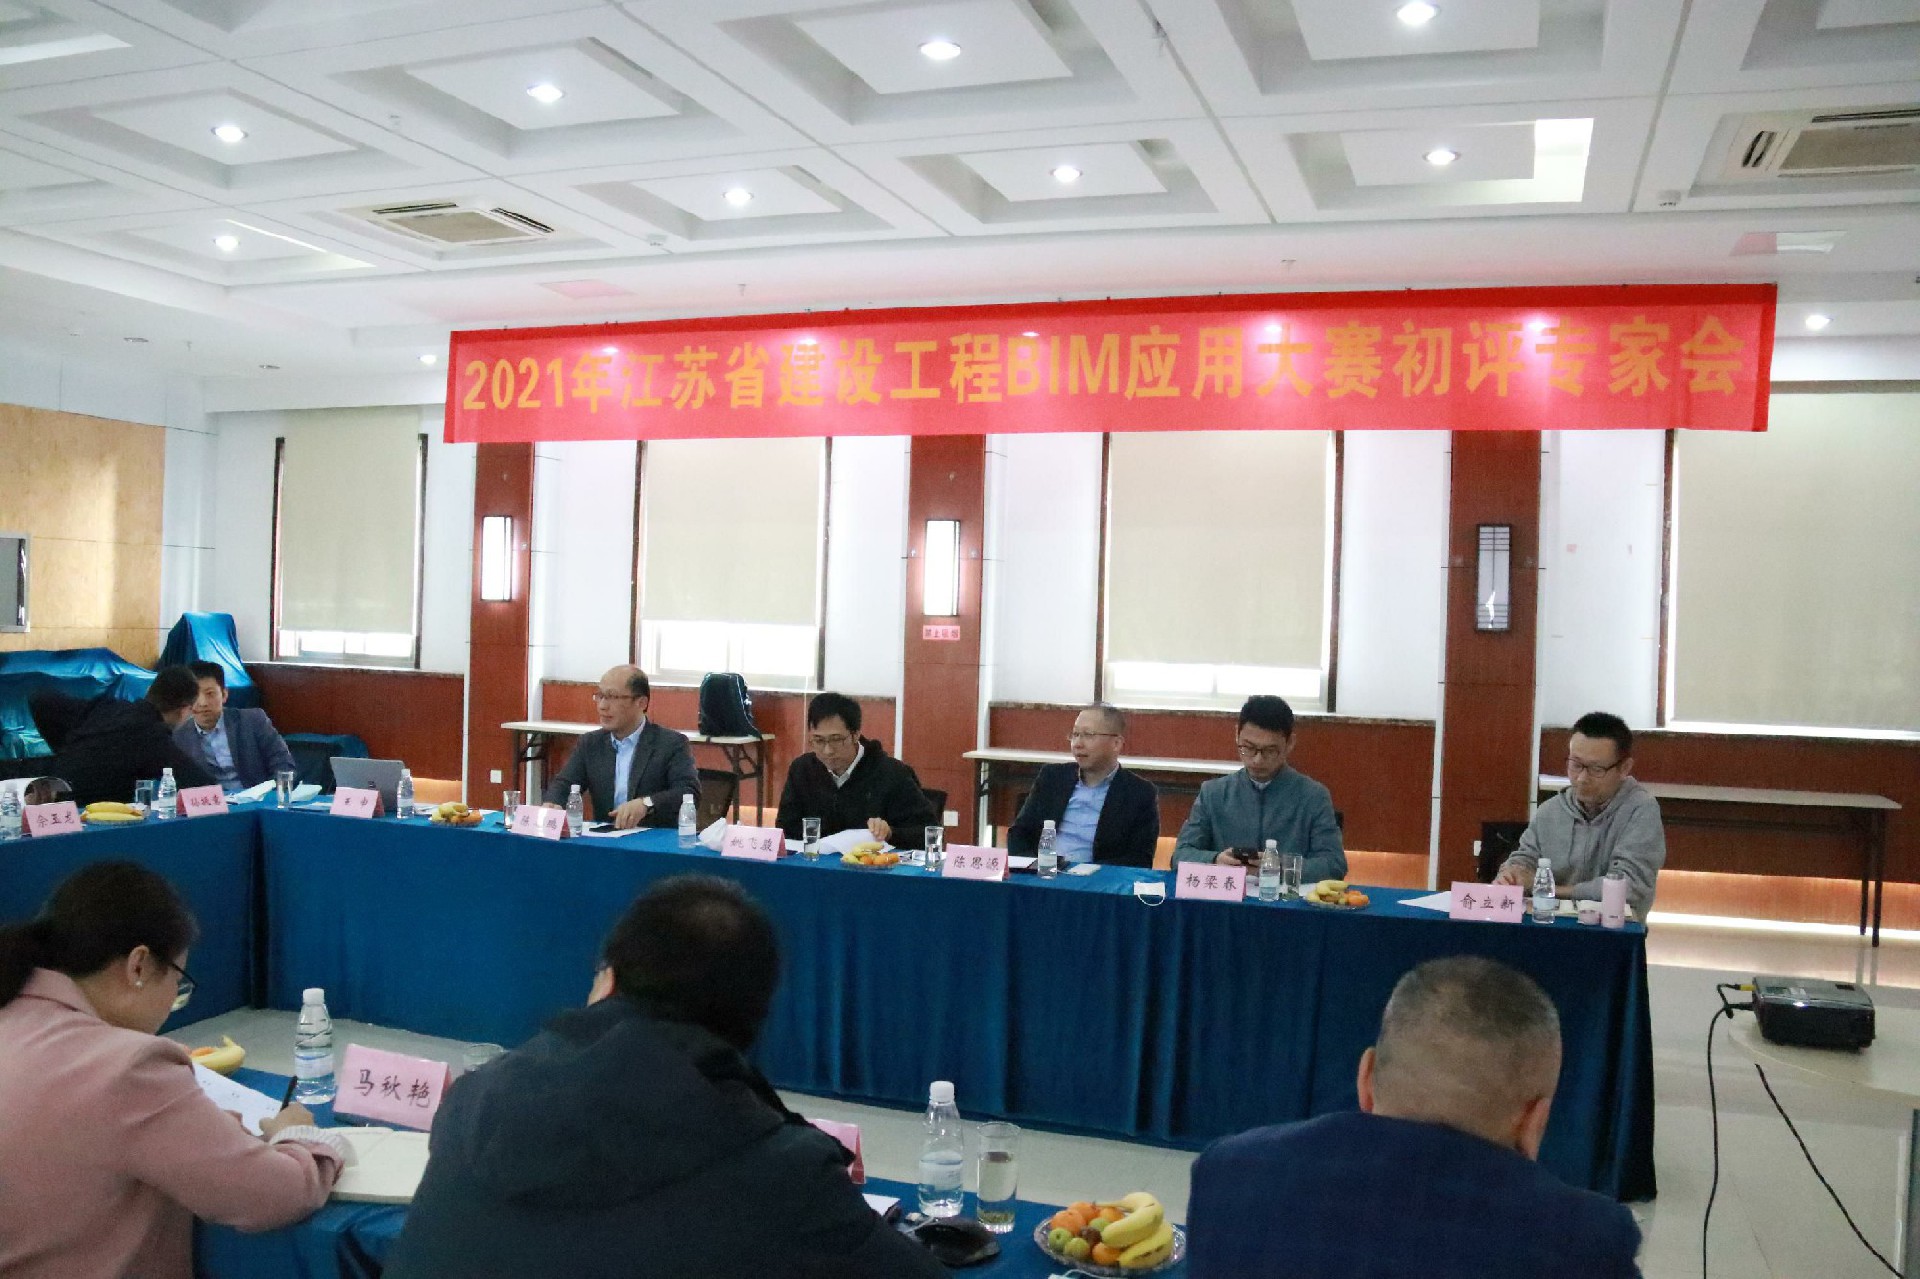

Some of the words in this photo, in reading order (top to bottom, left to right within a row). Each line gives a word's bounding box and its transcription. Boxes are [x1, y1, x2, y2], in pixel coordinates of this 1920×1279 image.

[463, 315, 1747, 414] 2021年江苏省建设工程BIM应用大赛初评专家会
[1185, 872, 1237, 891] 杨梁春
[1459, 892, 1516, 912] 俞立新
[353, 1068, 431, 1109] 马秋艳
